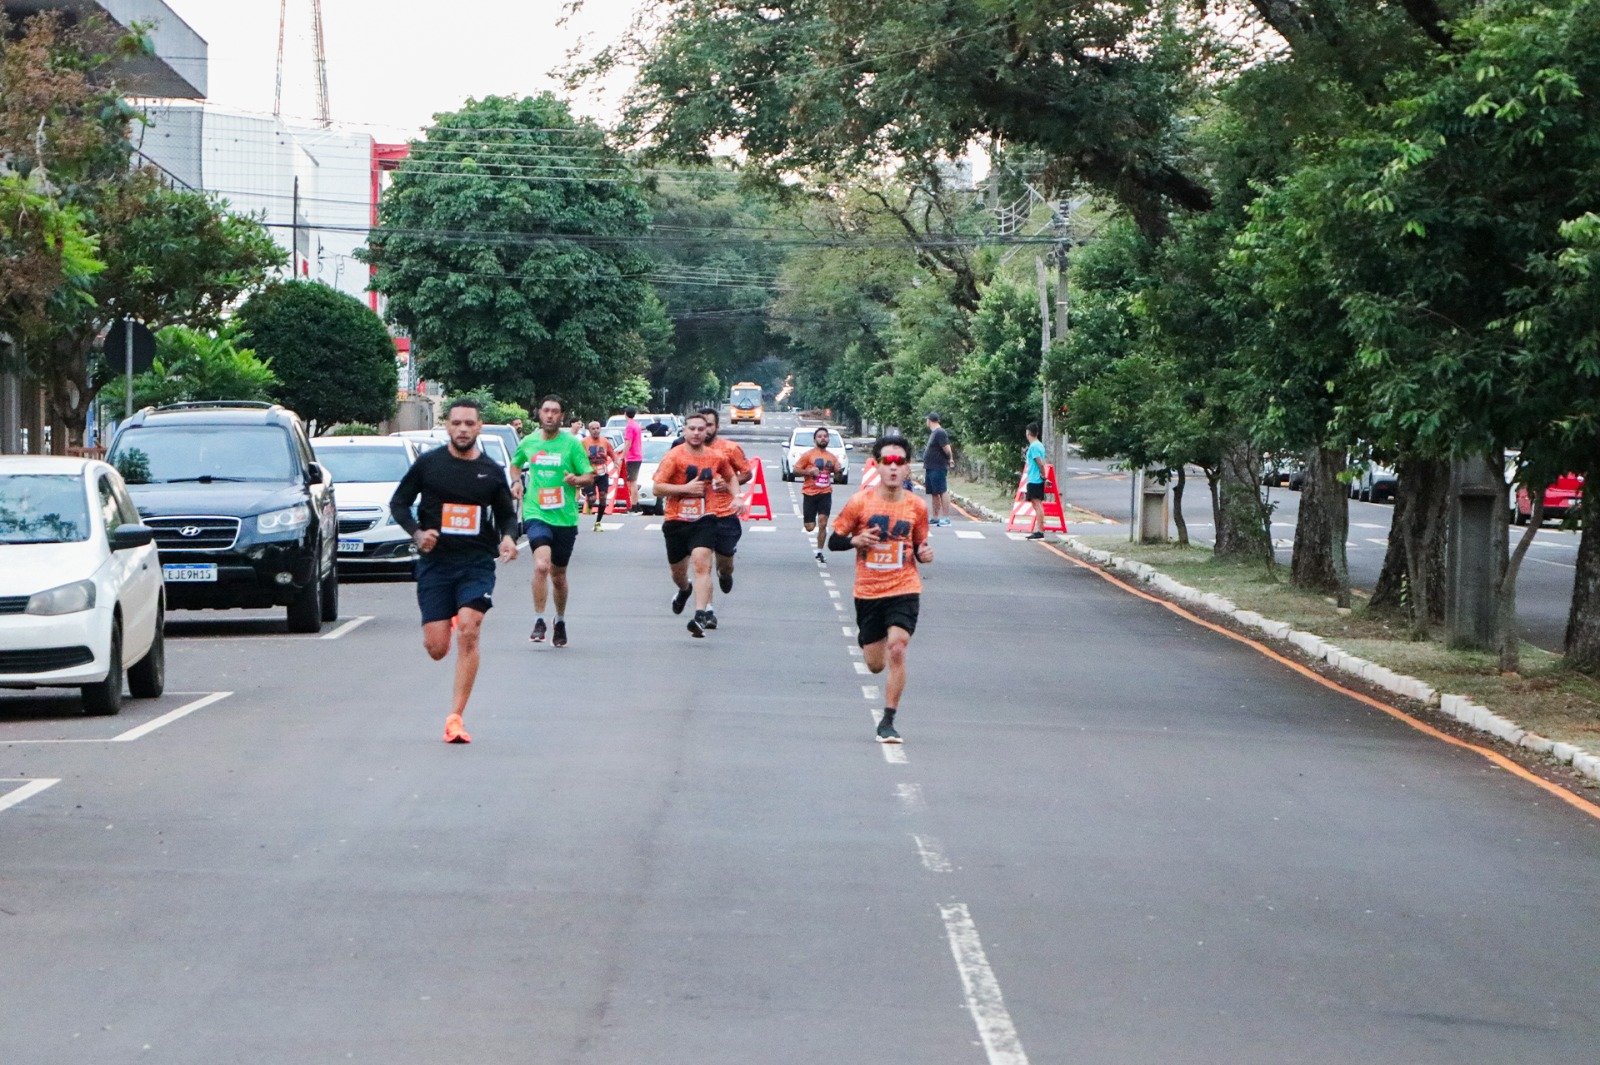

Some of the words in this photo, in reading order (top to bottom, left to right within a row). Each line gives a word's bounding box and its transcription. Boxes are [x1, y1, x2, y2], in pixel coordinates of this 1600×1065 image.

[543, 495, 558, 504] 155
[681, 506, 698, 514] 320
[449, 515, 470, 526] 189
[874, 552, 893, 563] 172
